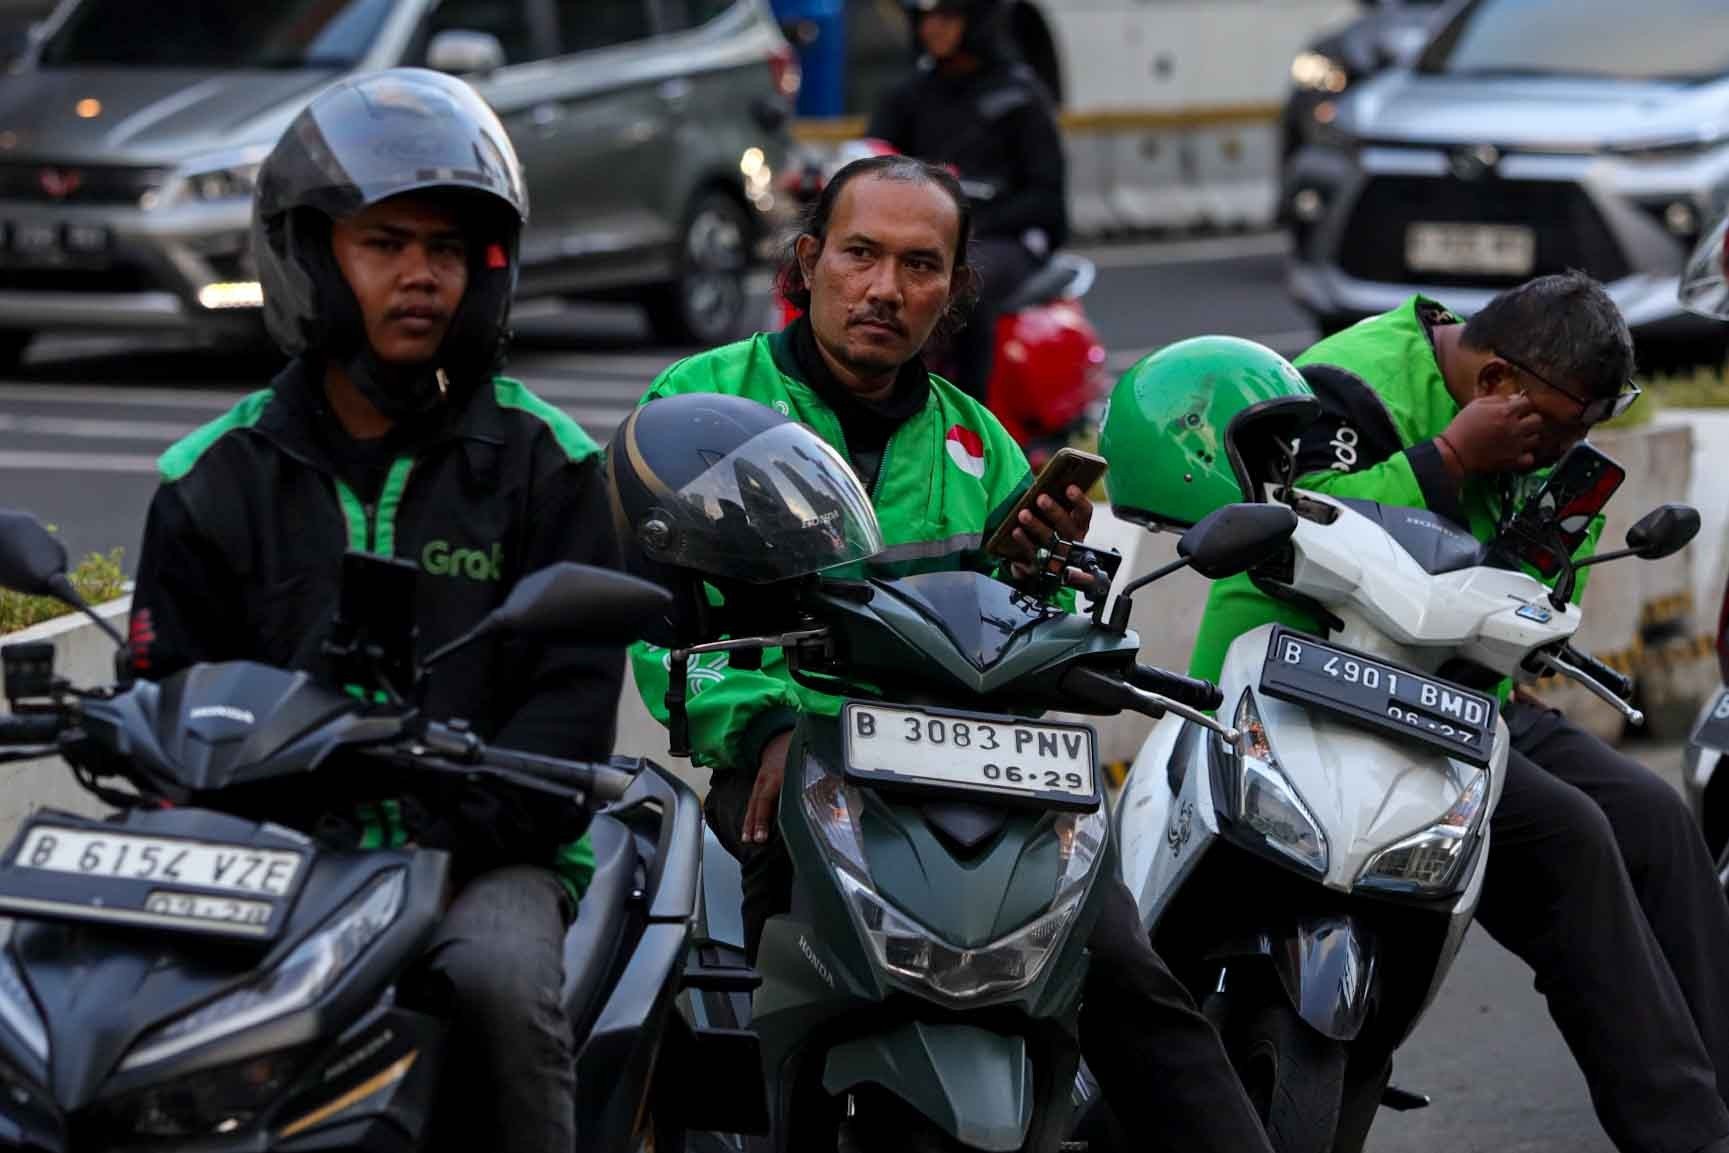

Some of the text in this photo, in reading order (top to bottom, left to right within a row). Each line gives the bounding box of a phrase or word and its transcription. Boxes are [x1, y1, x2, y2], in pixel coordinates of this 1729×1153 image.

[1284, 641, 1483, 725] B 4901 BMD
[856, 711, 1082, 760] B 3083 PNV
[31, 835, 290, 893] B 6154 VZE
[798, 935, 834, 988] HONDA
